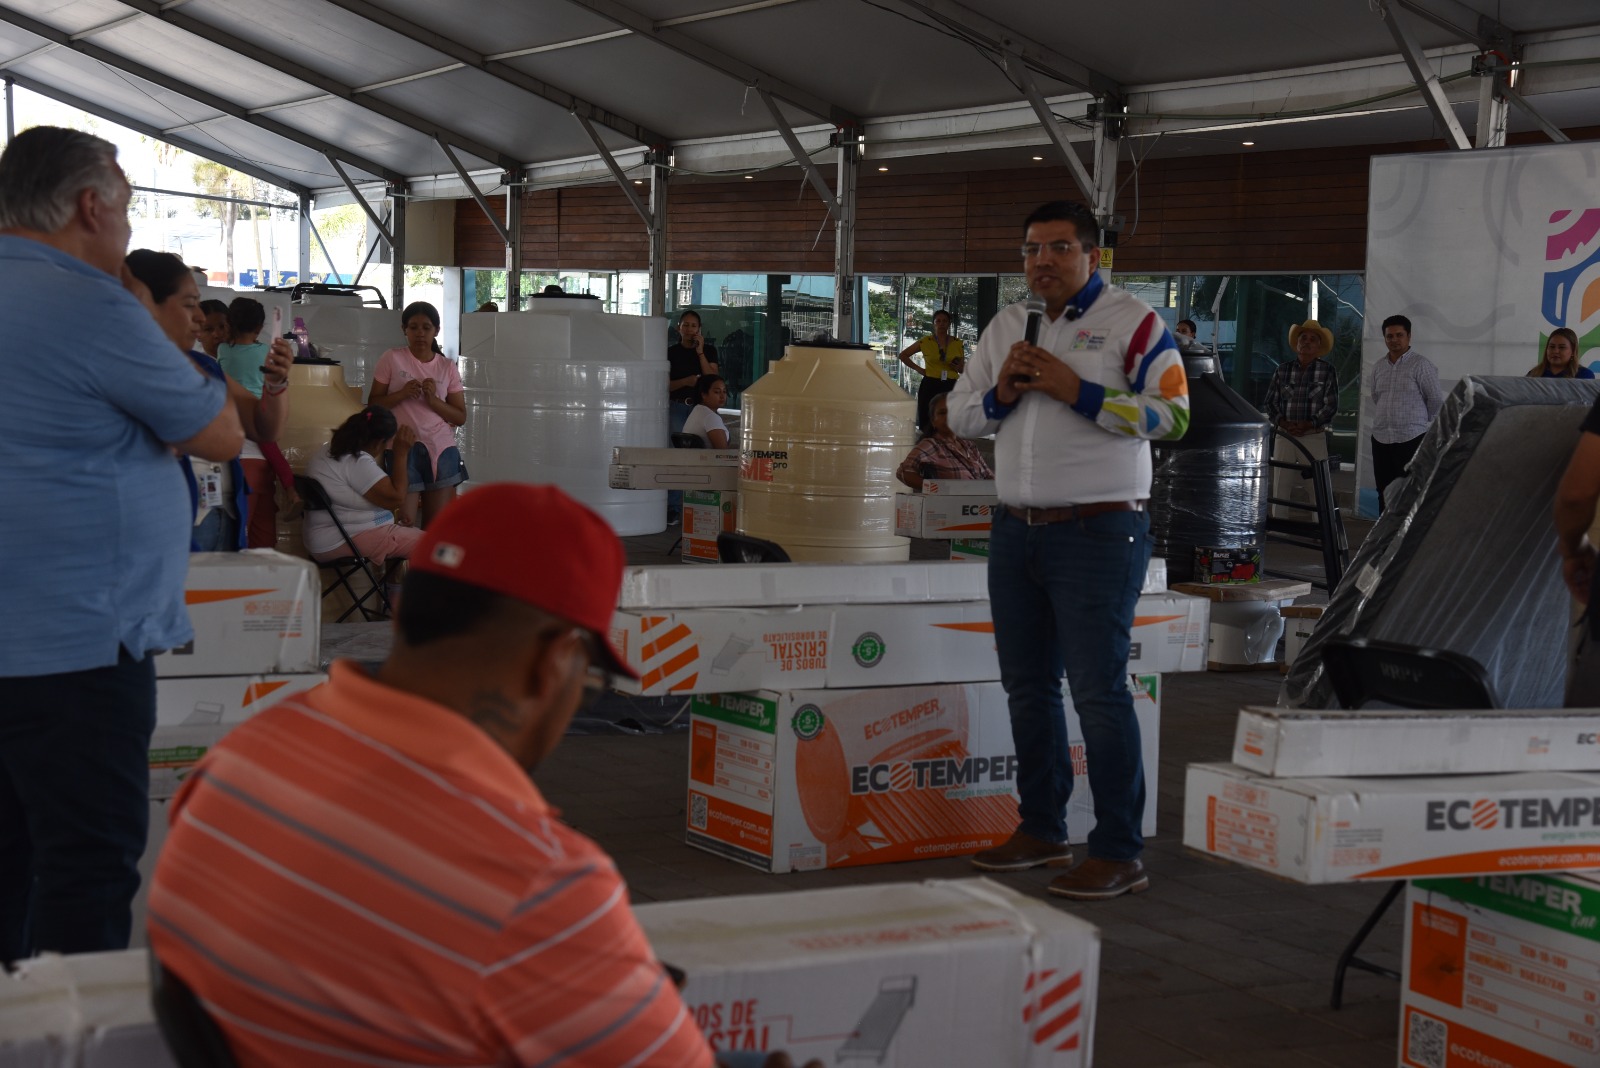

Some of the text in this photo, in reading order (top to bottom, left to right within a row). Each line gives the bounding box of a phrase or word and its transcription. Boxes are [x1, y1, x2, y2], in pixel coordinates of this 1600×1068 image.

[773, 462, 788, 470] pro
[762, 630, 828, 643] DE BOROSILICATO
[770, 640, 827, 659] CRISTAL
[780, 657, 827, 672] TUBOS DE
[863, 697, 940, 740] ECOTEMPER
[708, 809, 770, 836] ecotemper.com.mx
[913, 838, 993, 855] ecotemper.com.mx
[731, 998, 758, 1026] DE
